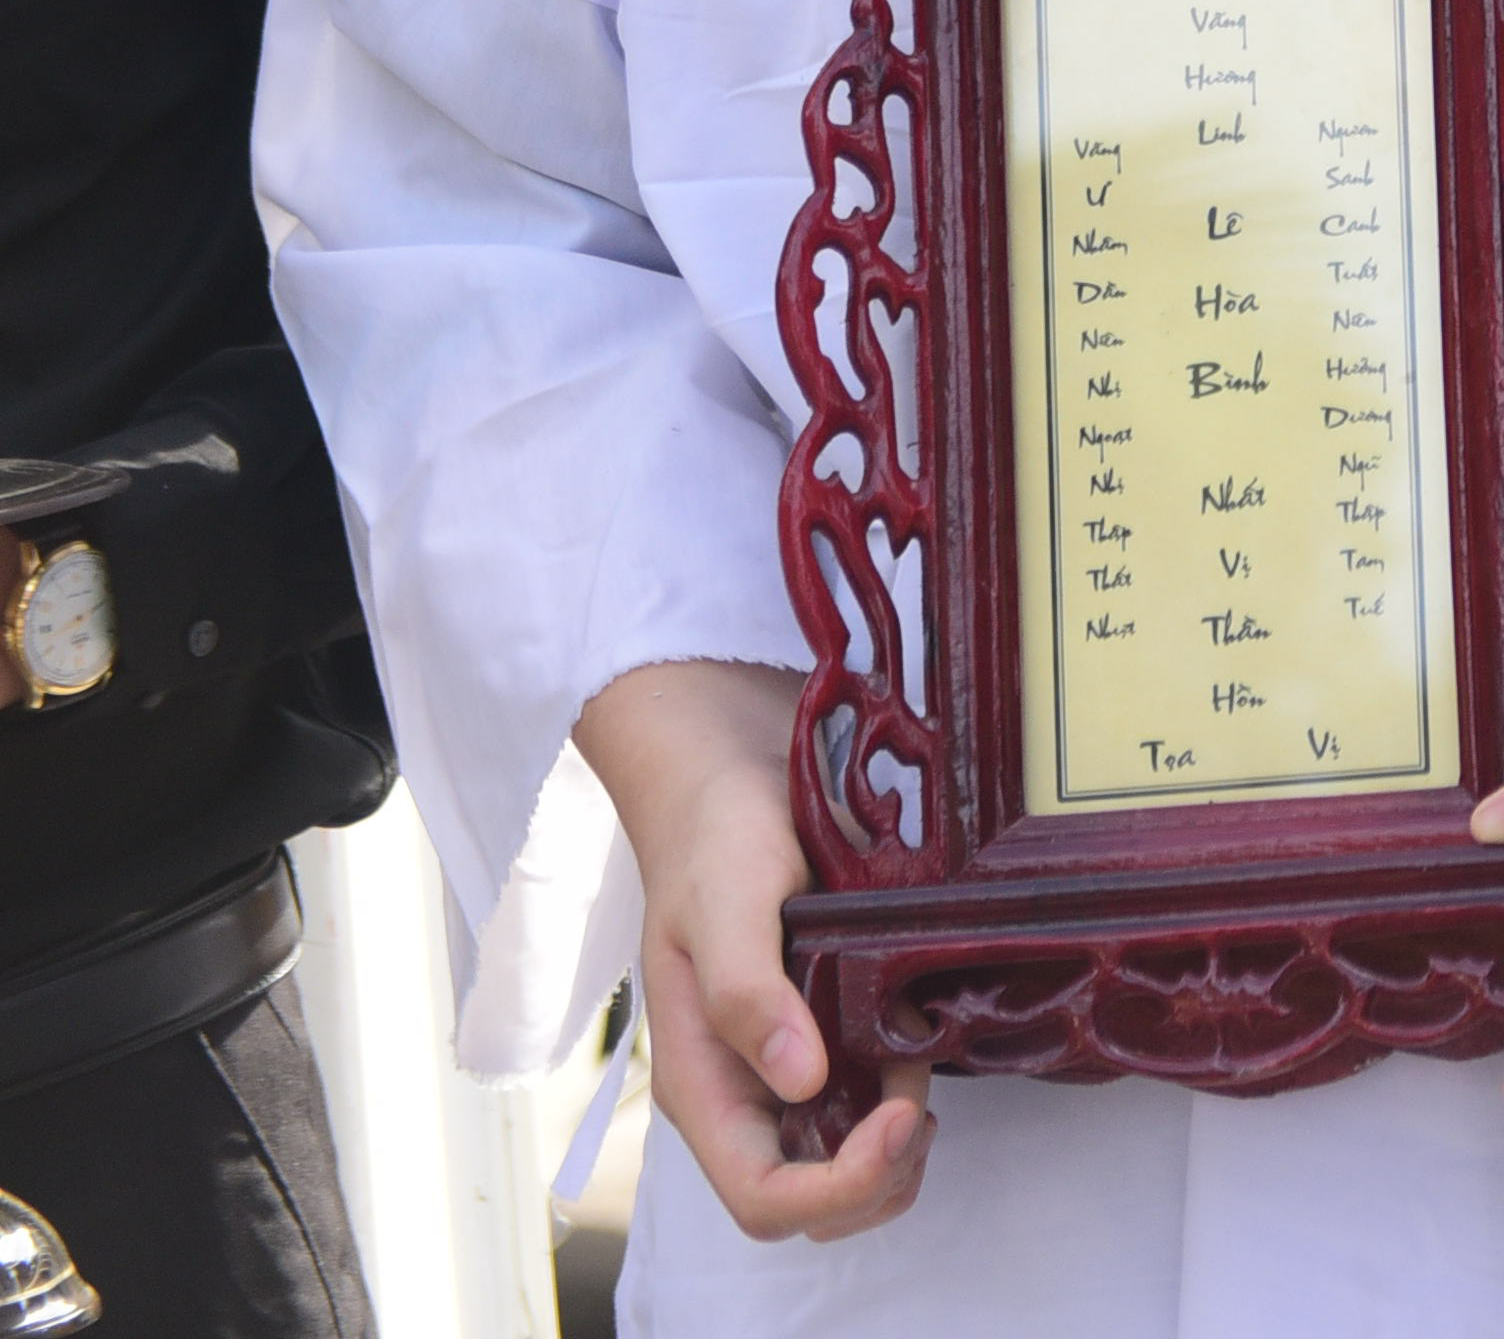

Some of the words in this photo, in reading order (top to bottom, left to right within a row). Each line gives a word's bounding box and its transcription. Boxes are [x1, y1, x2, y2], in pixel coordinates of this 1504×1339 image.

[1190, 7, 1247, 50] Vãng
[1198, 112, 1246, 145] Linh
[1074, 139, 1121, 174] Vãng
[1326, 160, 1374, 189] Sanh
[1208, 206, 1242, 240] Lê
[1320, 207, 1380, 236] Canh
[1327, 257, 1378, 283] Tuất
[1195, 284, 1259, 321] Hòa
[1333, 309, 1376, 332] Niên
[1081, 329, 1124, 351] Niên
[1088, 371, 1121, 399] Nhị
[1186, 351, 1269, 399] Bình
[1091, 471, 1124, 495] Nhị
[1202, 476, 1265, 514] Nhất
[1220, 548, 1251, 578] Vị
[1340, 549, 1384, 571] Tam
[1201, 609, 1271, 645] Thần
[1213, 682, 1265, 714] Hồn
[1140, 741, 1195, 771] Tọa
[1308, 728, 1340, 760] Vị
